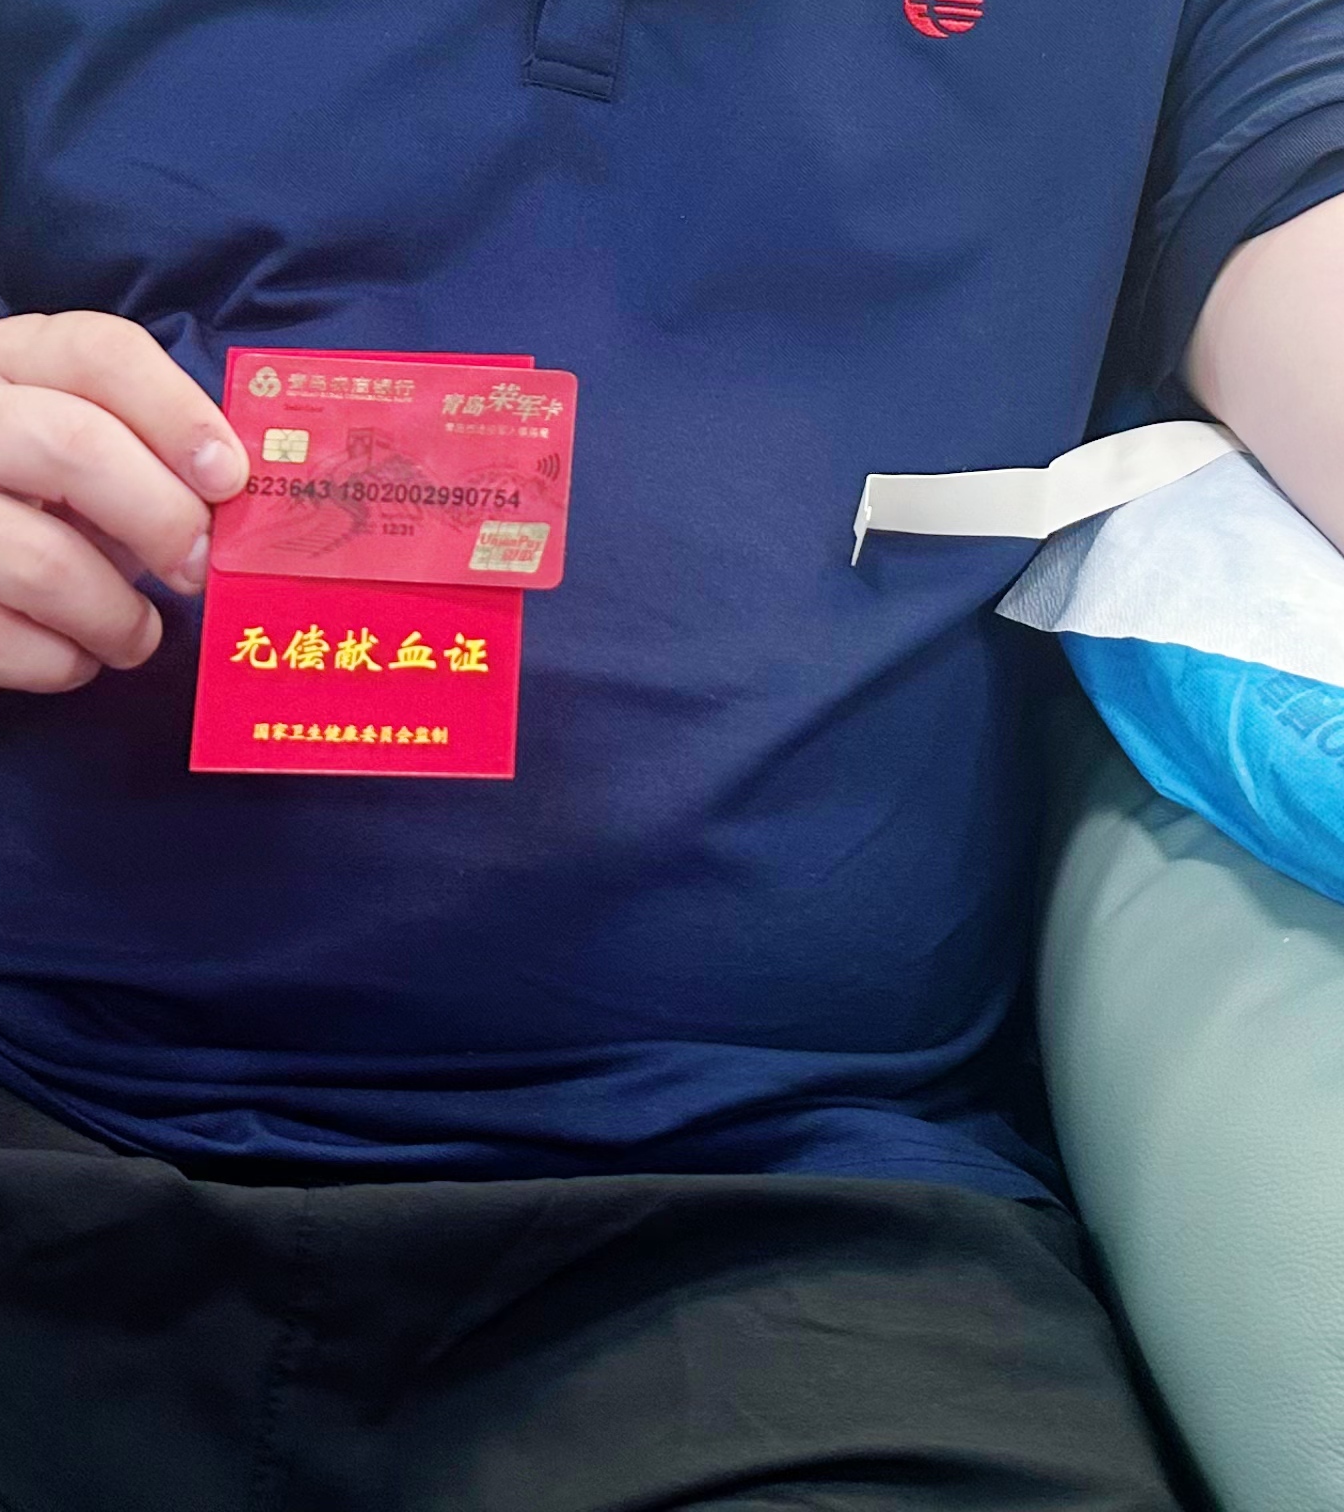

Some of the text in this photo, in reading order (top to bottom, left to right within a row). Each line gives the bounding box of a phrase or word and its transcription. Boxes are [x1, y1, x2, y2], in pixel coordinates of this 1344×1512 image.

[246, 476, 331, 499] 623643
[480, 532, 542, 552] UnionPay
[230, 624, 490, 673] 无偿献血证
[253, 723, 448, 745] 国家卫生健康委员会监制
